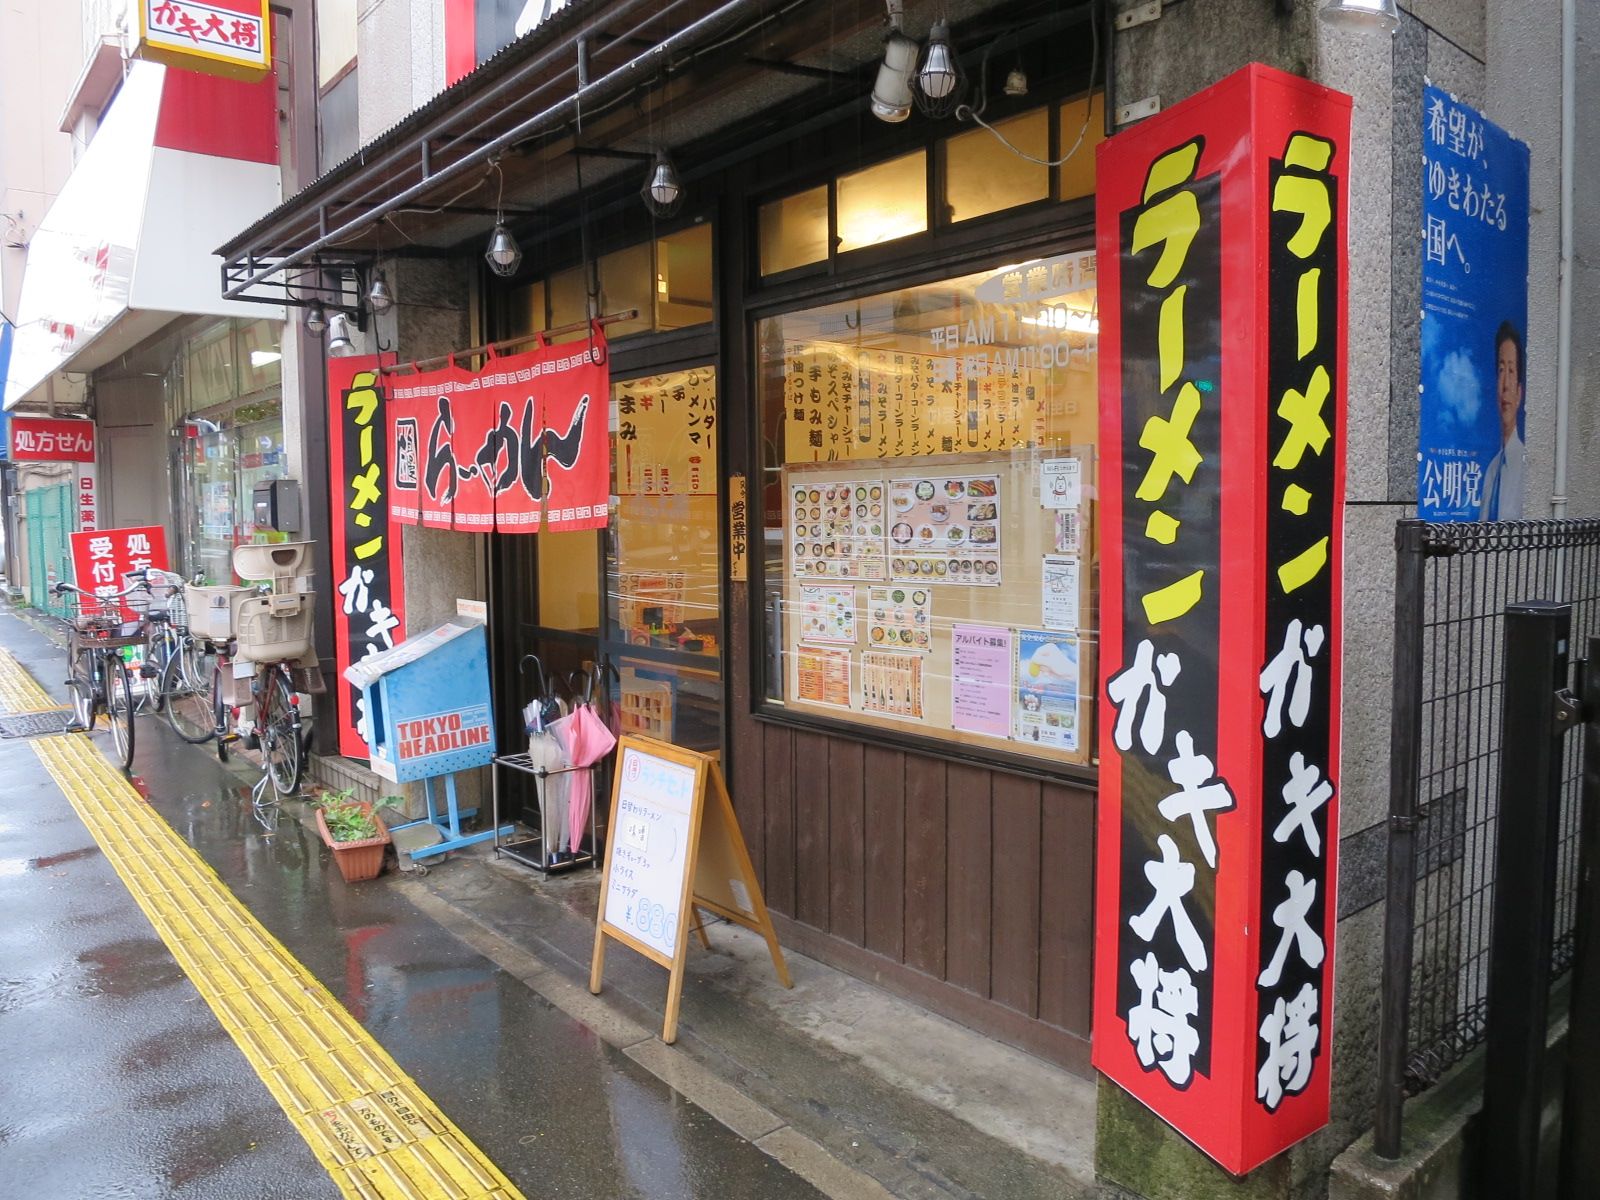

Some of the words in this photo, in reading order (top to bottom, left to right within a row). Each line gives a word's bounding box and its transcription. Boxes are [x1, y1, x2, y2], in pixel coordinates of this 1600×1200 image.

[1427, 96, 1489, 170] 希望が、
[1428, 160, 1508, 232] ゆきわたる
[1427, 213, 1471, 274] 国へ。
[14, 427, 93, 454] 処方せん
[1422, 458, 1483, 510] 公明党
[732, 500, 746, 561] 営業中
[397, 713, 461, 742] TOKYO
[399, 725, 491, 759] HEADLINE
